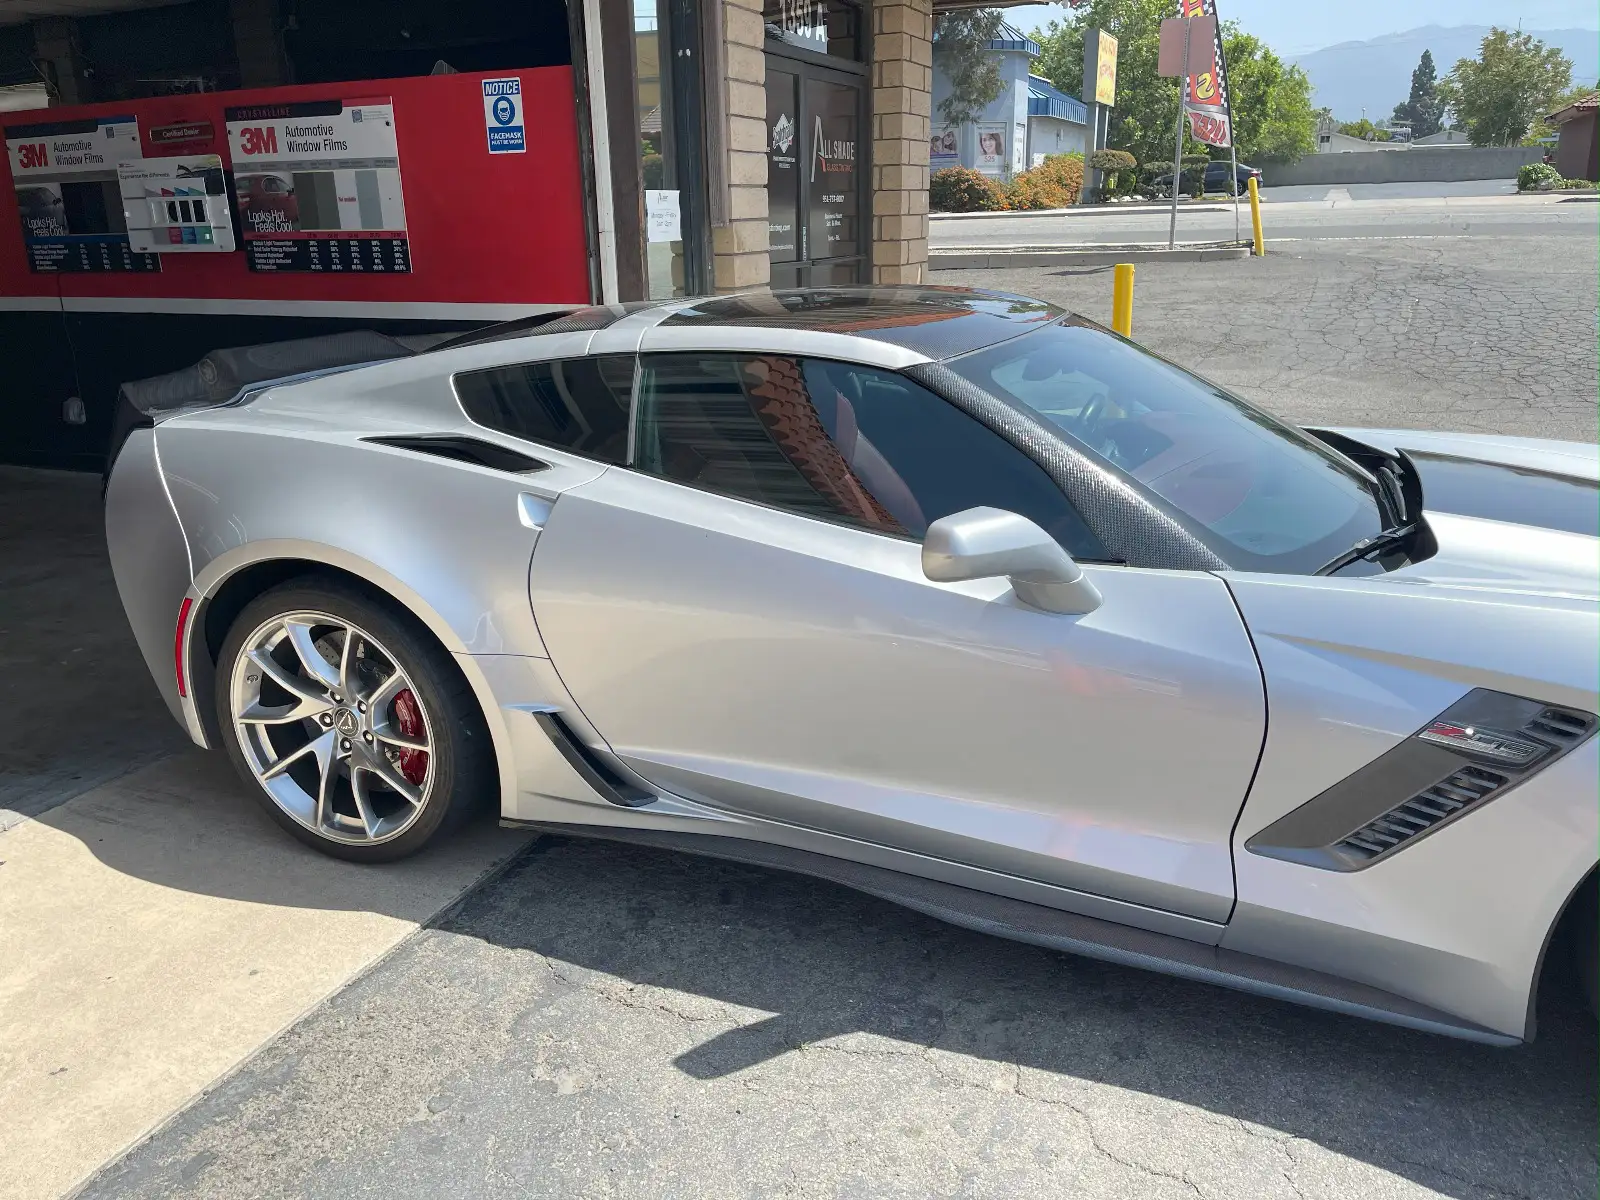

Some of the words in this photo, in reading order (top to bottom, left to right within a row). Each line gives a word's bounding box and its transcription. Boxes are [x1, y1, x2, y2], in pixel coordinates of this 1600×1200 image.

[485, 82, 519, 95] NOTICE
[236, 107, 292, 119] CRYSTALLINE
[285, 125, 334, 138] Automotive
[490, 132, 522, 140] FACEMASK
[53, 140, 92, 153] Automotive
[239, 126, 278, 155] 3M
[286, 139, 321, 153] Window
[323, 138, 348, 152] Films
[17, 143, 48, 169] 3M
[833, 140, 855, 160] SHADE
[55, 154, 83, 166] Window
[84, 153, 104, 164] Films
[247, 210, 271, 222] Looks
[271, 209, 288, 222] Hot.
[27, 217, 45, 229] Looks
[254, 221, 275, 232] Feels
[275, 220, 295, 232] Cool.
[33, 227, 49, 237] Feels
